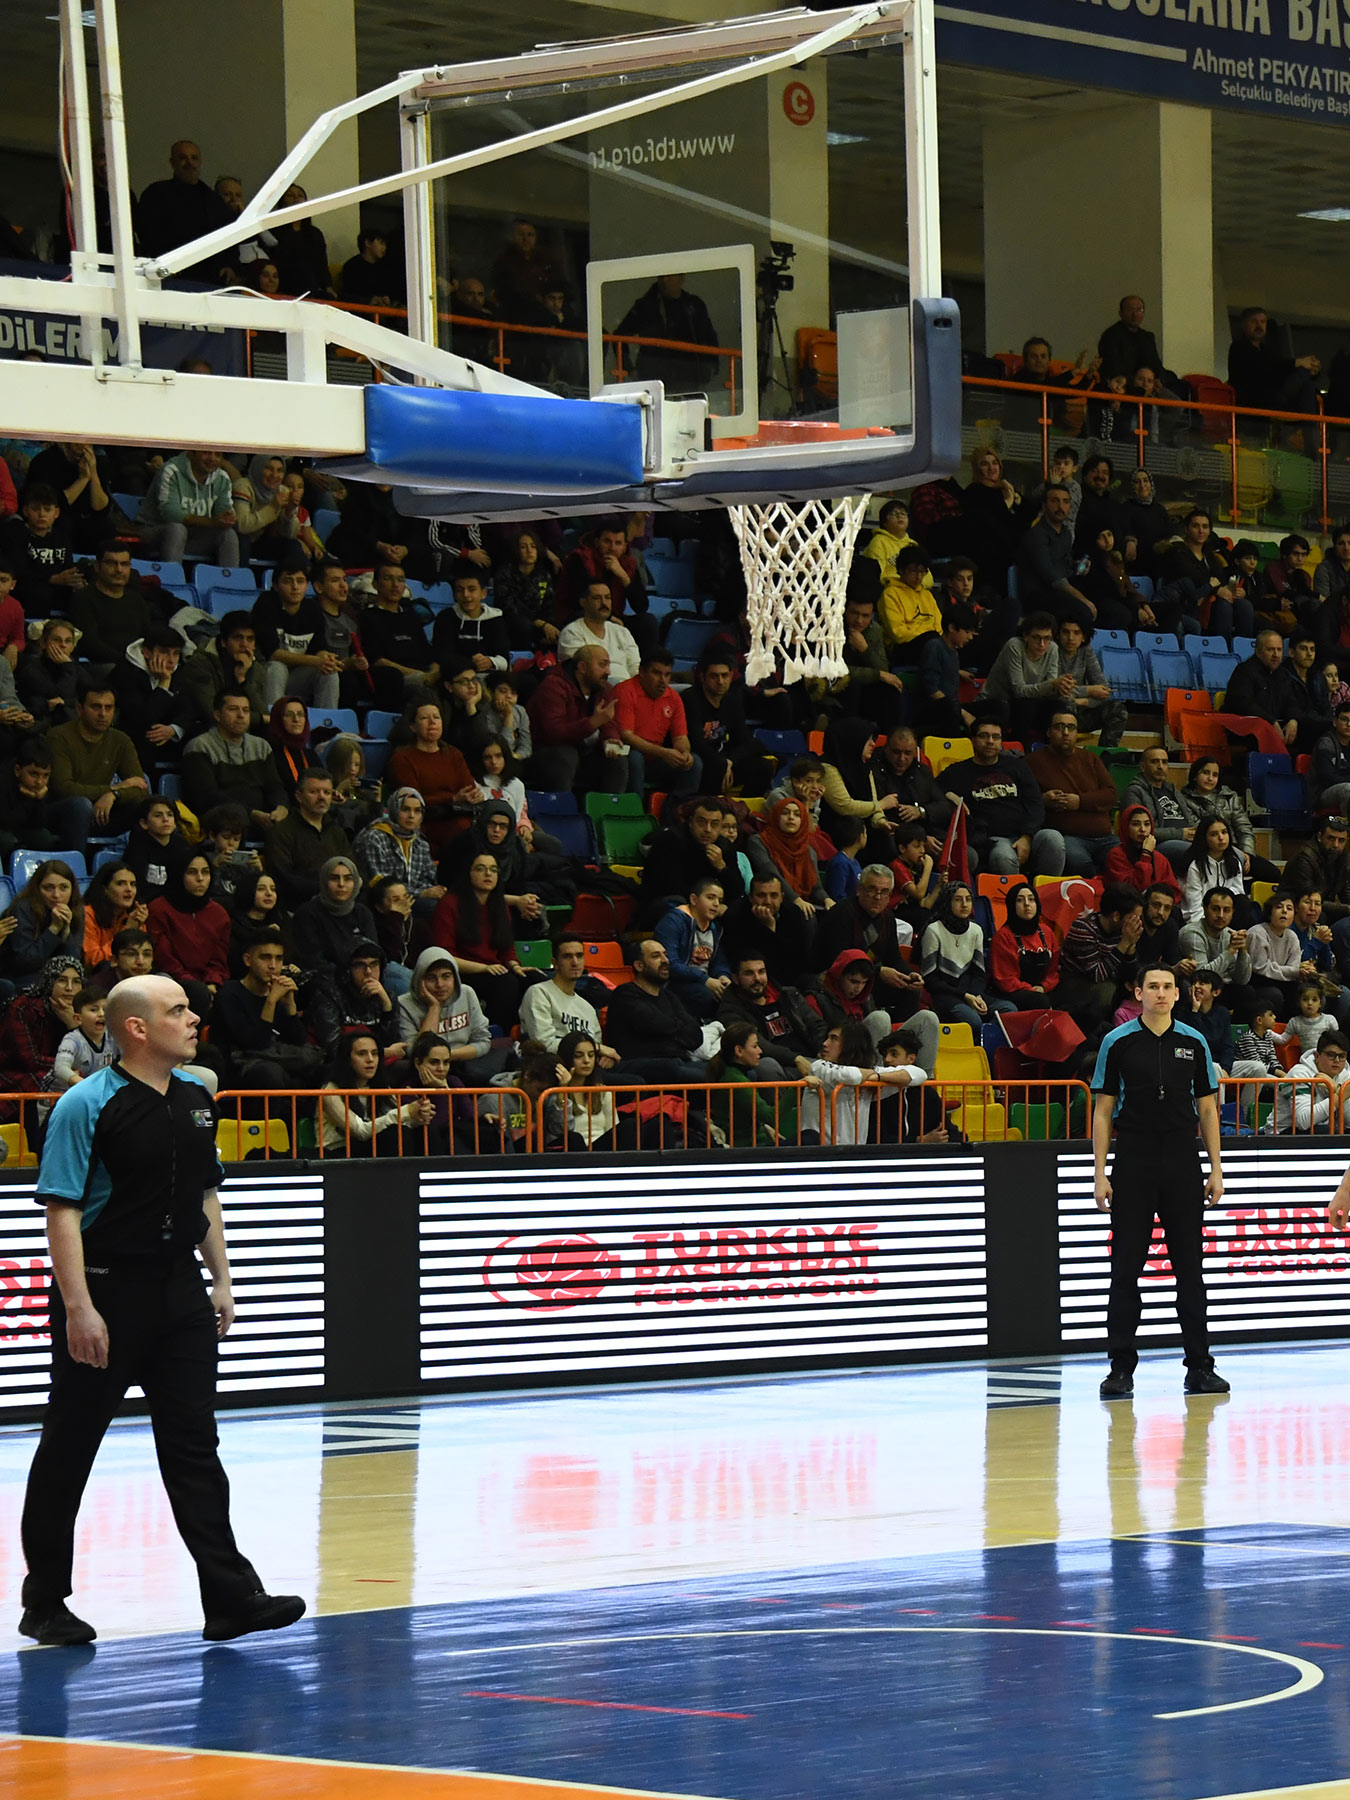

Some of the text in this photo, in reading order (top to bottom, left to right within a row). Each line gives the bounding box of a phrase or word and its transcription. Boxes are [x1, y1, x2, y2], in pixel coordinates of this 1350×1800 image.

[1192, 48, 1254, 80] Ahmet
[1221, 81, 1272, 103] Selçuklu
[1275, 89, 1325, 112] Belediye
